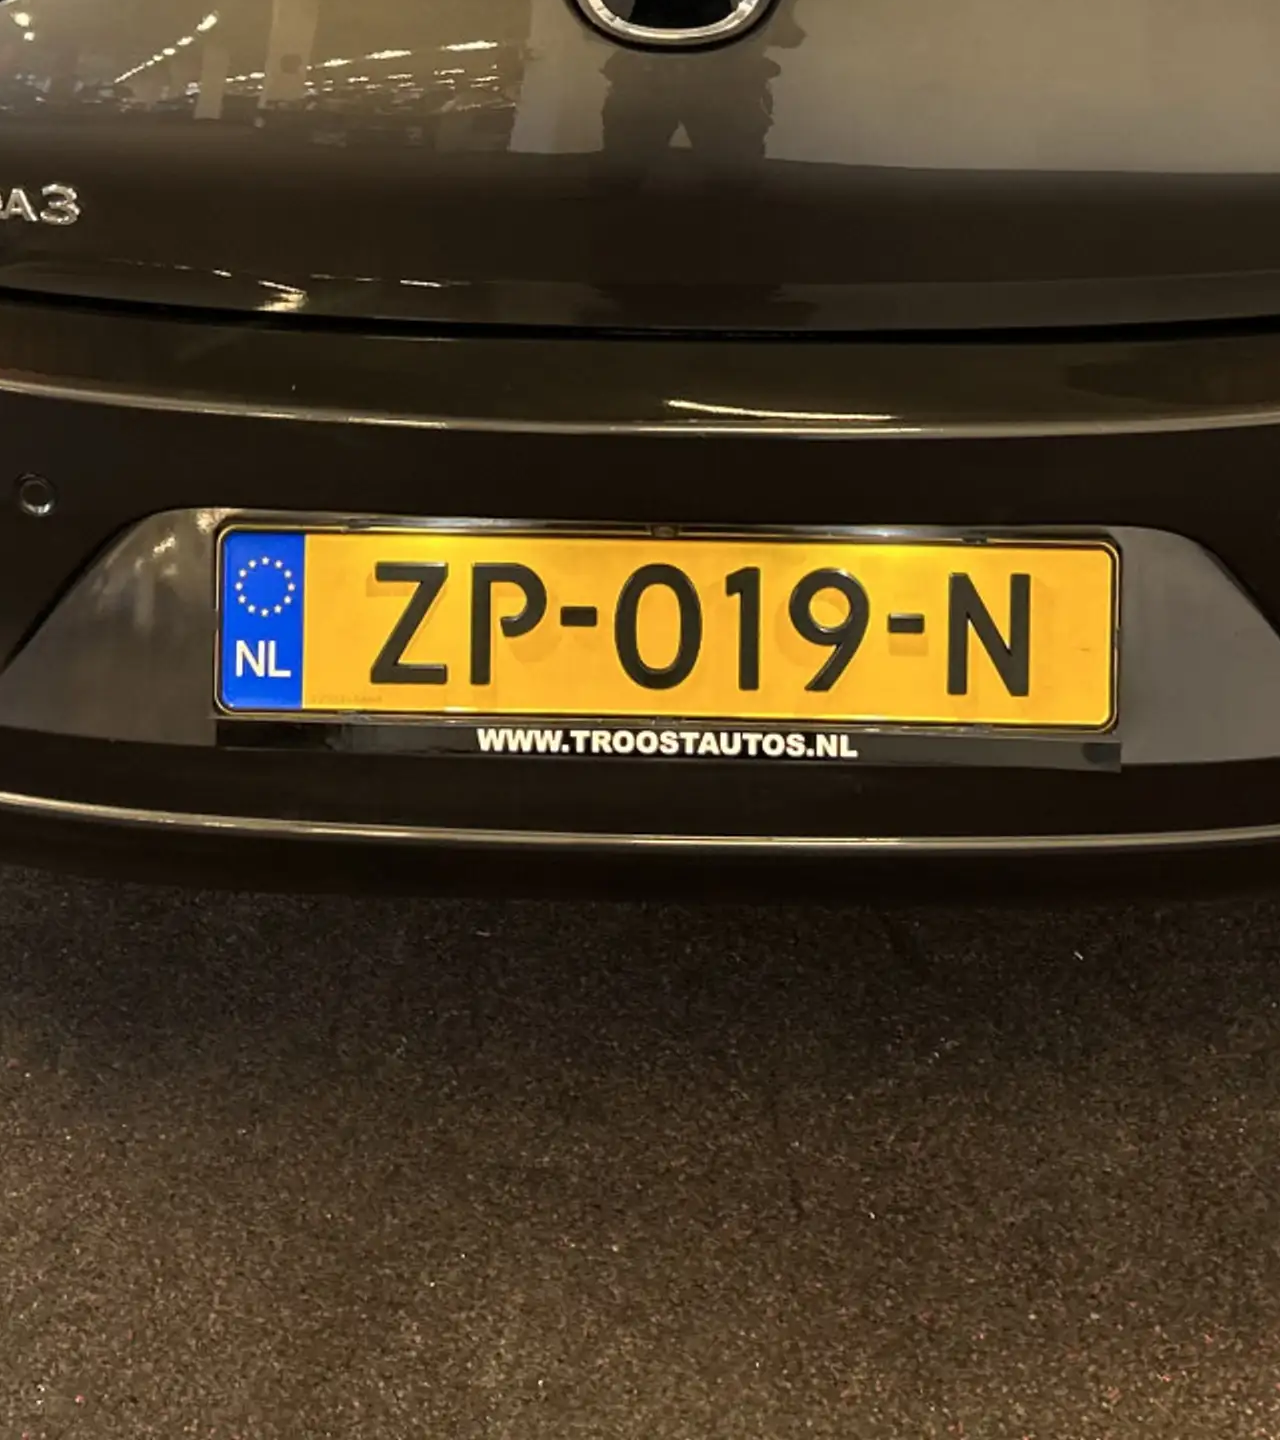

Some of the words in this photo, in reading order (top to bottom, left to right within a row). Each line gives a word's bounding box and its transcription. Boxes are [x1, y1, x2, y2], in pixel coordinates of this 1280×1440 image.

[369, 561, 1031, 697] ZP-019-N
[236, 640, 291, 677] NL
[477, 728, 858, 758] WWW.TROOSTAUTOS.NL
